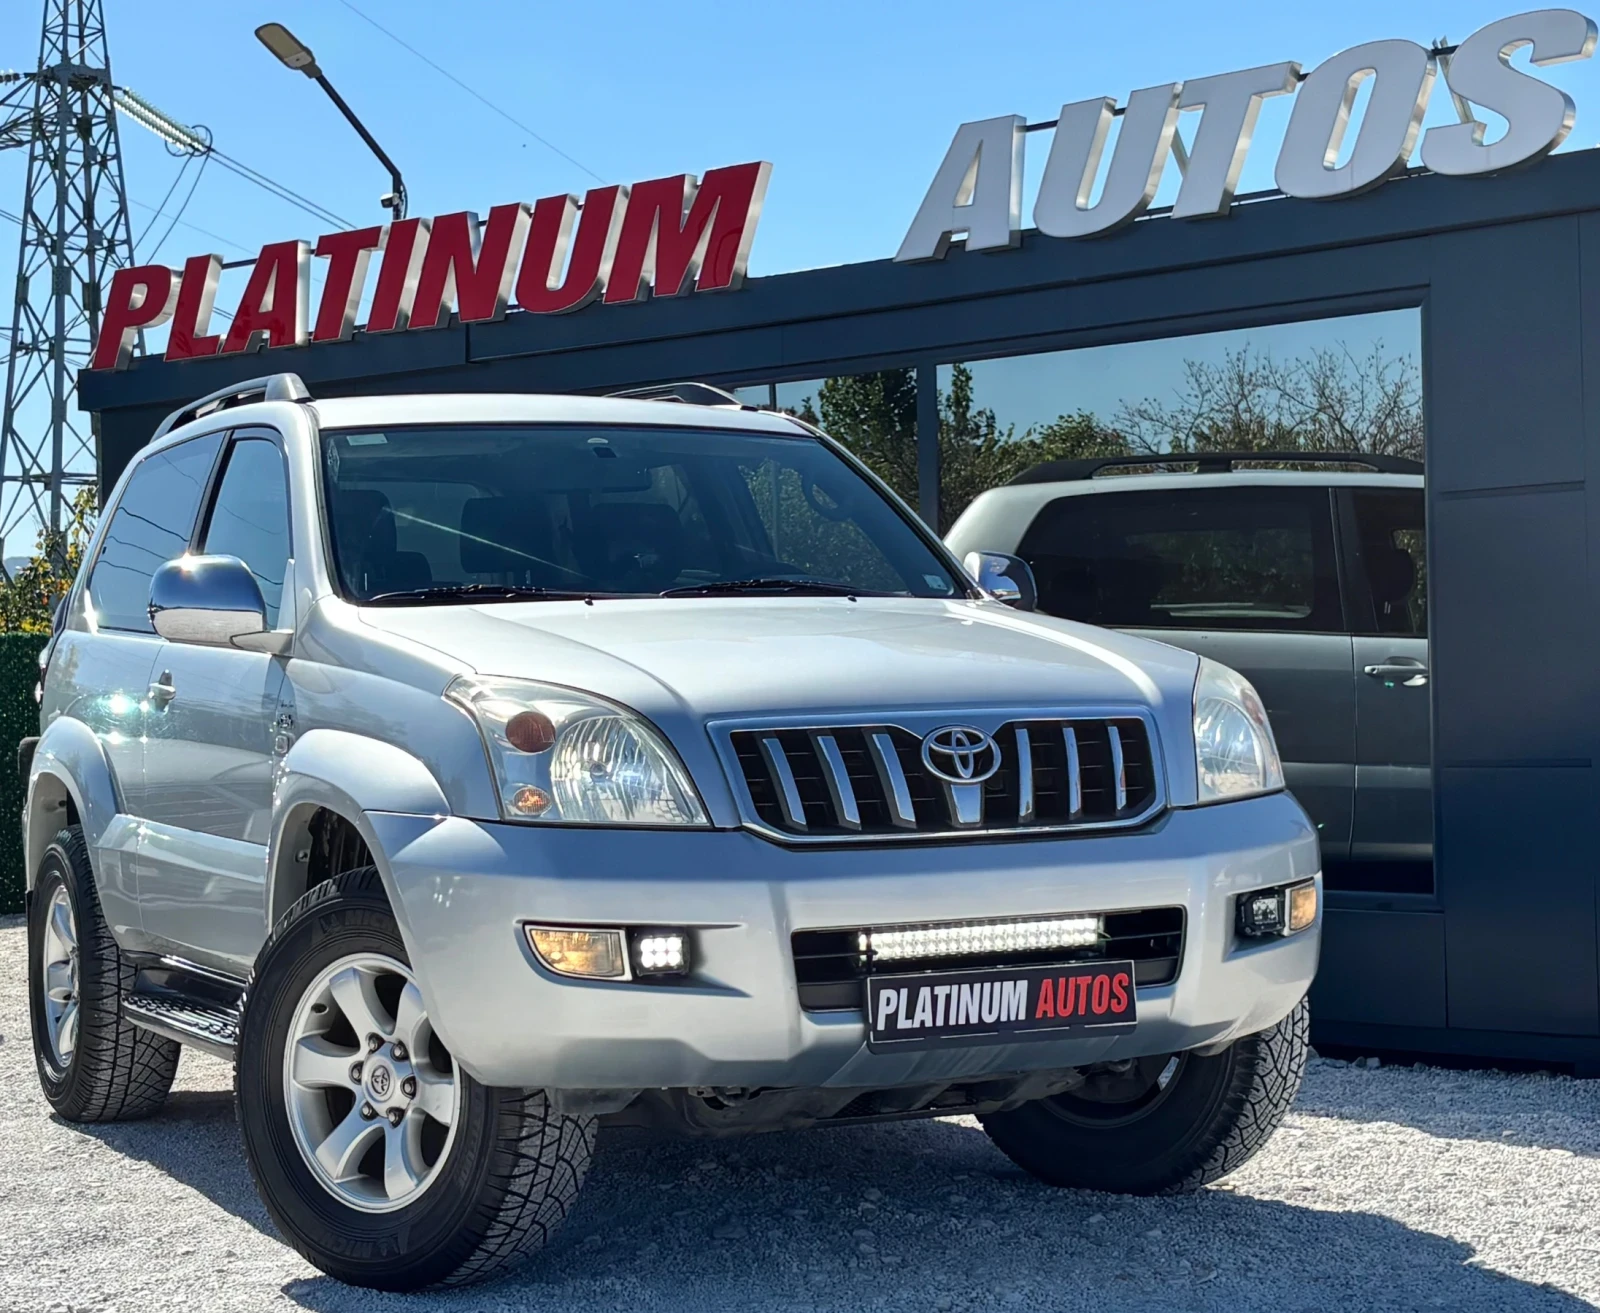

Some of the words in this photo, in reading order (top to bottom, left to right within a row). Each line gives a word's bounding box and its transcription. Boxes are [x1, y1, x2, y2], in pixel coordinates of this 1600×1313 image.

[93, 161, 772, 371] PLATINUM
[893, 8, 1599, 263] AUTOS
[876, 979, 1028, 1031] PLATINUM
[1035, 972, 1130, 1019] AUTOS
